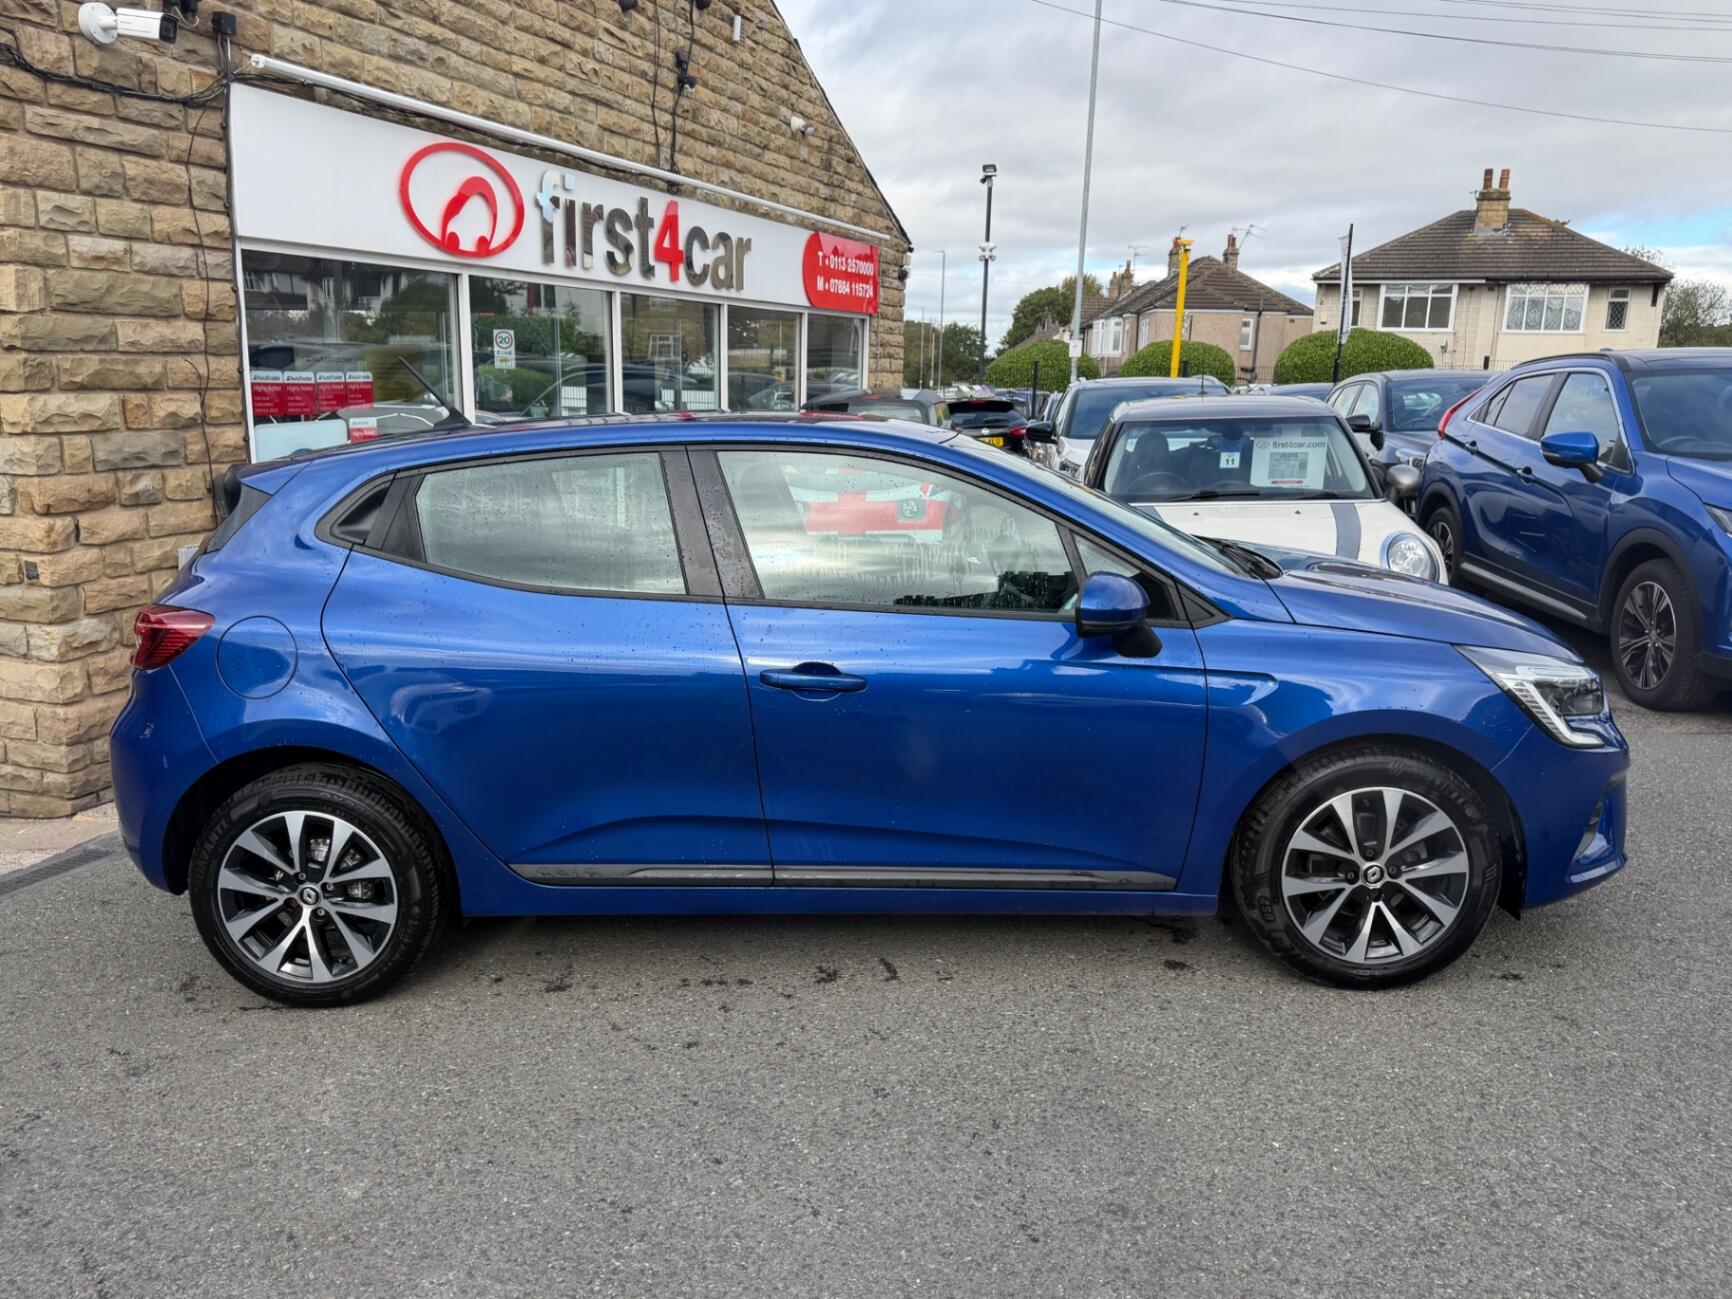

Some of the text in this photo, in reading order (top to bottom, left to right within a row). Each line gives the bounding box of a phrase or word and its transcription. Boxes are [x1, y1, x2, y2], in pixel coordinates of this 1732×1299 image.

[536, 169, 752, 291] first4car
[817, 251, 874, 276] T 0113 2570000
[816, 275, 824, 292] M
[829, 278, 850, 296] 07884
[498, 335, 510, 344] 20
[1225, 457, 1235, 466] 11
